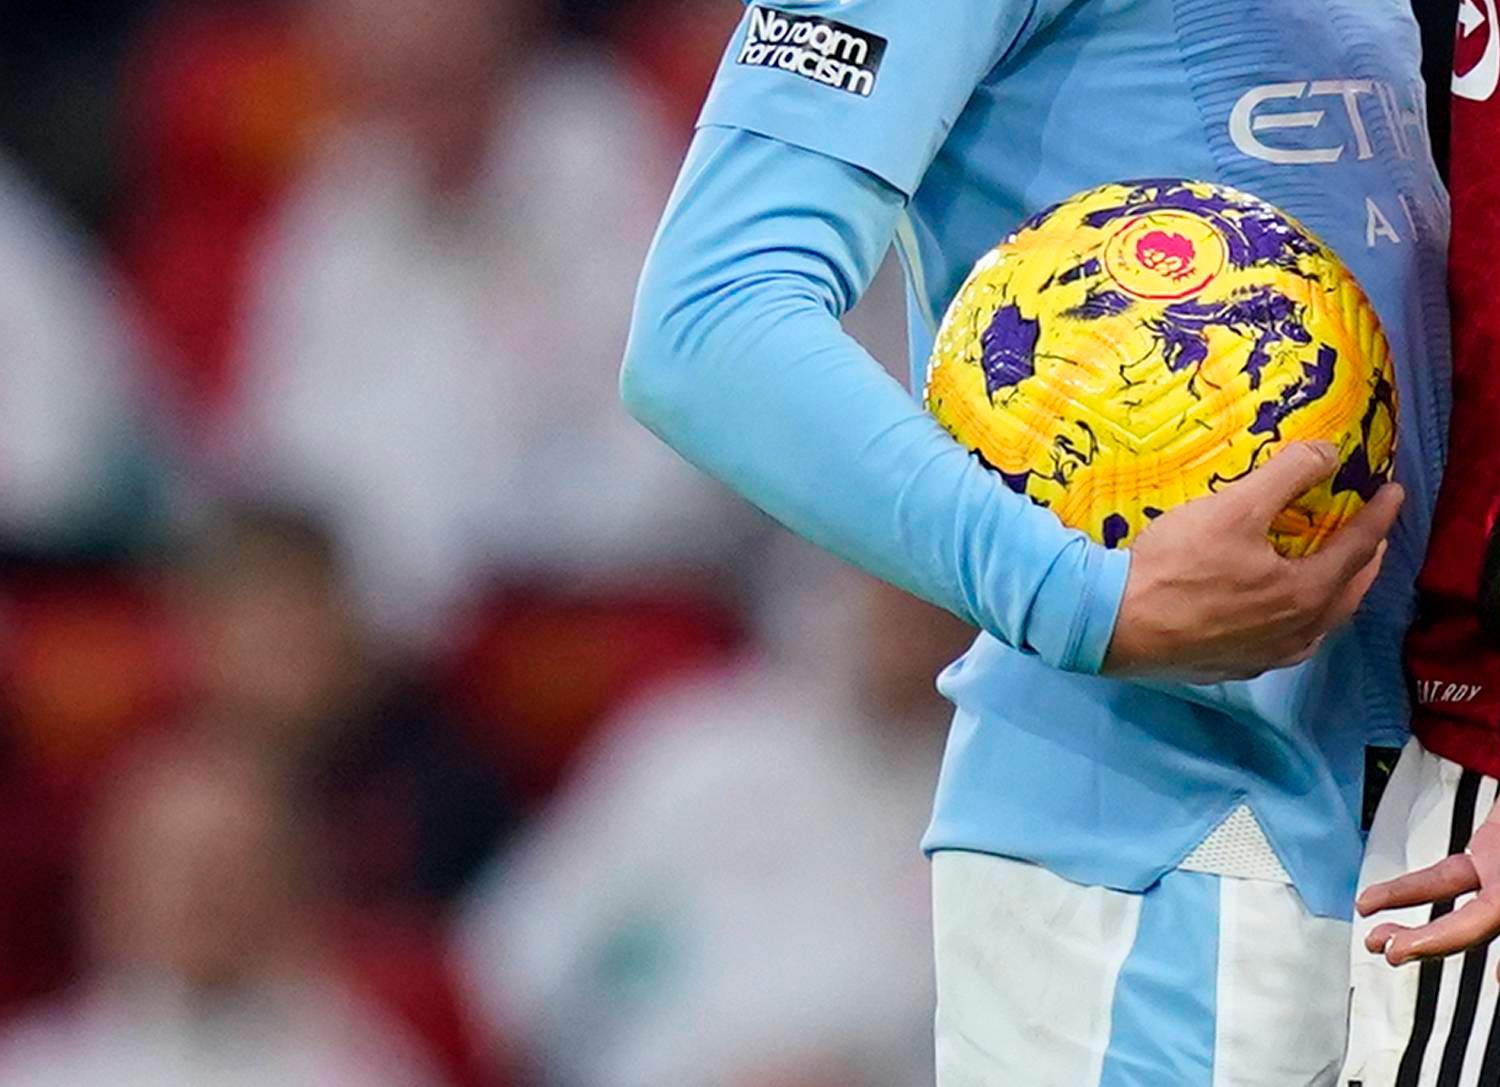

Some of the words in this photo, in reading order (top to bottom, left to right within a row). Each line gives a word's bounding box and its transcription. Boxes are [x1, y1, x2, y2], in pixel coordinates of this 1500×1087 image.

[747, 7, 788, 43] No
[784, 22, 869, 64] room
[737, 37, 774, 64] for
[768, 45, 875, 96] racism
